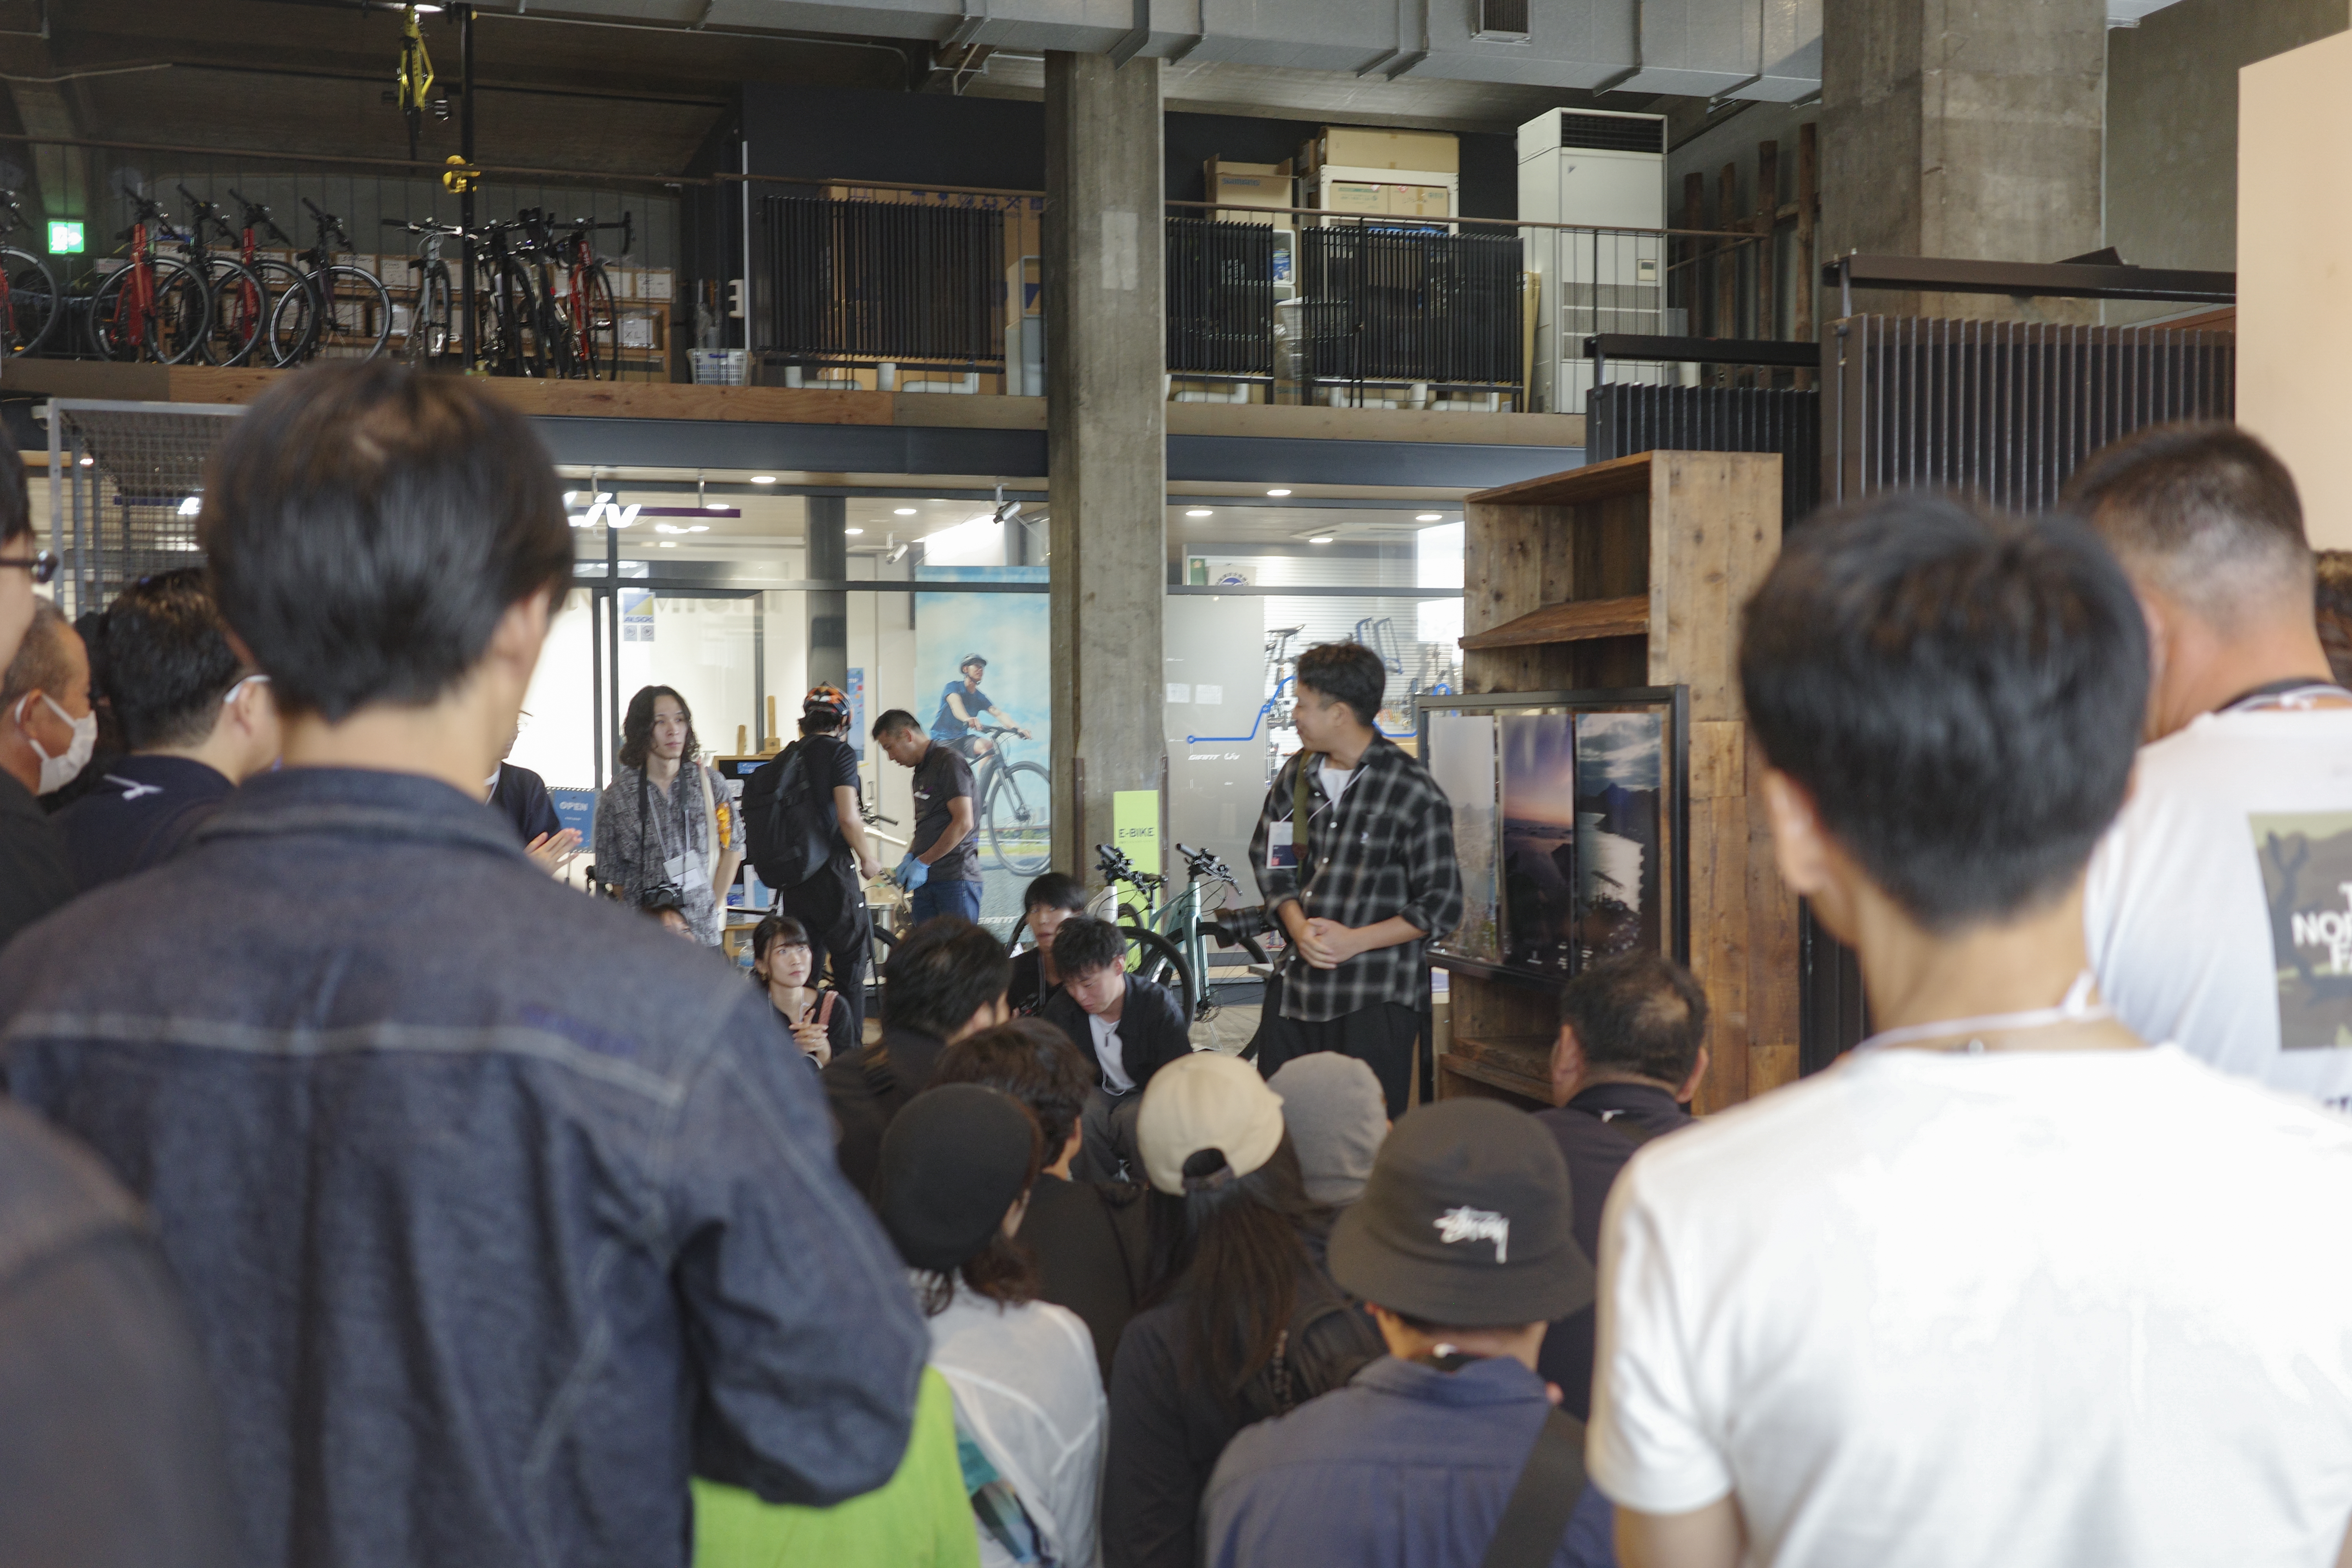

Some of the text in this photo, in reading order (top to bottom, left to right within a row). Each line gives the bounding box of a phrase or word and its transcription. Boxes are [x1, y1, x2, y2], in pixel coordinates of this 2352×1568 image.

[559, 801, 588, 811] OPEN
[1119, 827, 1154, 838] E-BIKE
[977, 916, 1018, 925] GIANT
